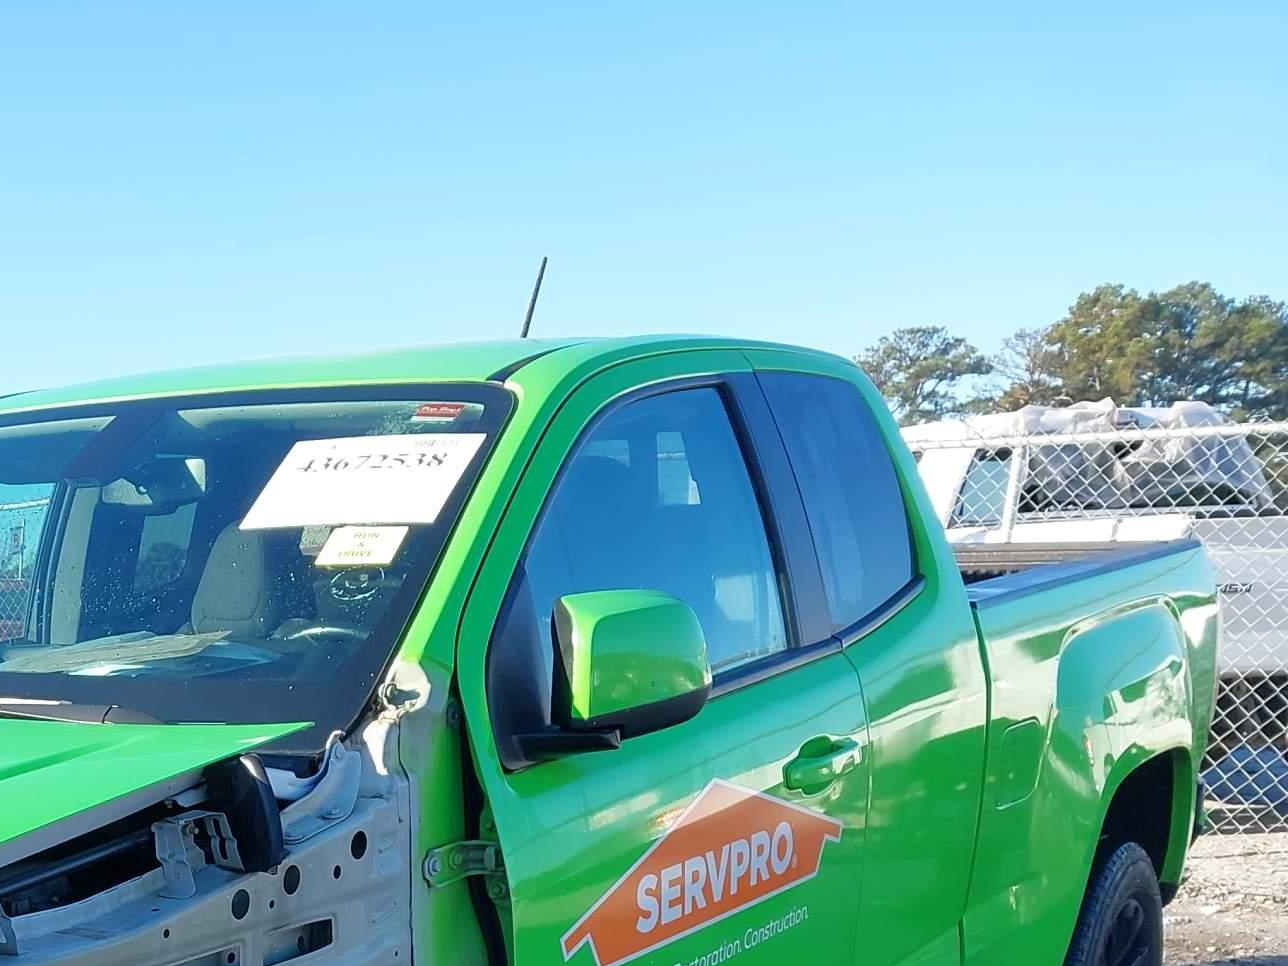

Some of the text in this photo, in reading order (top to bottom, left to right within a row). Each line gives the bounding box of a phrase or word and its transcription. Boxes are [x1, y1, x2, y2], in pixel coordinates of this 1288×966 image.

[297, 452, 447, 473] 43672538
[636, 821, 795, 934] SERVPRO
[743, 905, 810, 950] Construction.
